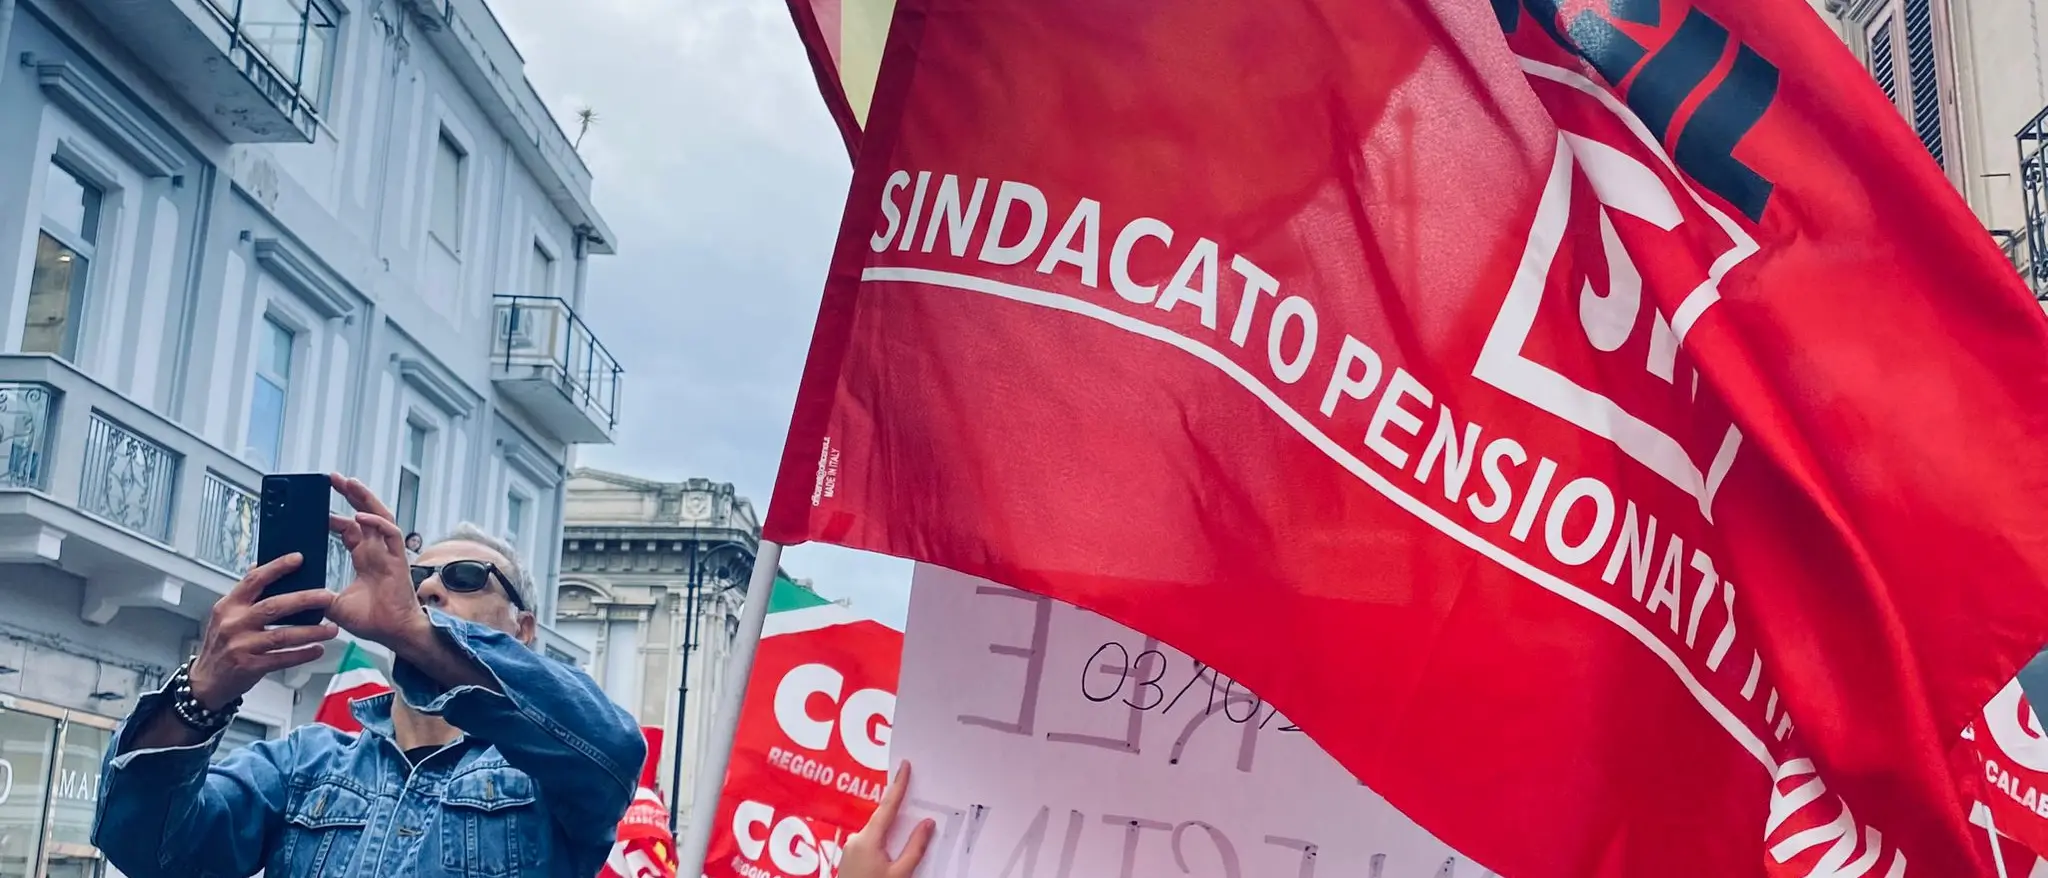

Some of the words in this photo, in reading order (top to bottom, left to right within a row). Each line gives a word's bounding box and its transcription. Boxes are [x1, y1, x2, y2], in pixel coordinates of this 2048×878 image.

[870, 170, 1319, 384] SINDACATO
[1320, 333, 1737, 672] PENSIONATI
[829, 447, 840, 468] ITALY
[823, 476, 836, 497] MADE
[1082, 641, 1303, 734] 03/10/
[767, 746, 834, 786] REGGIO
